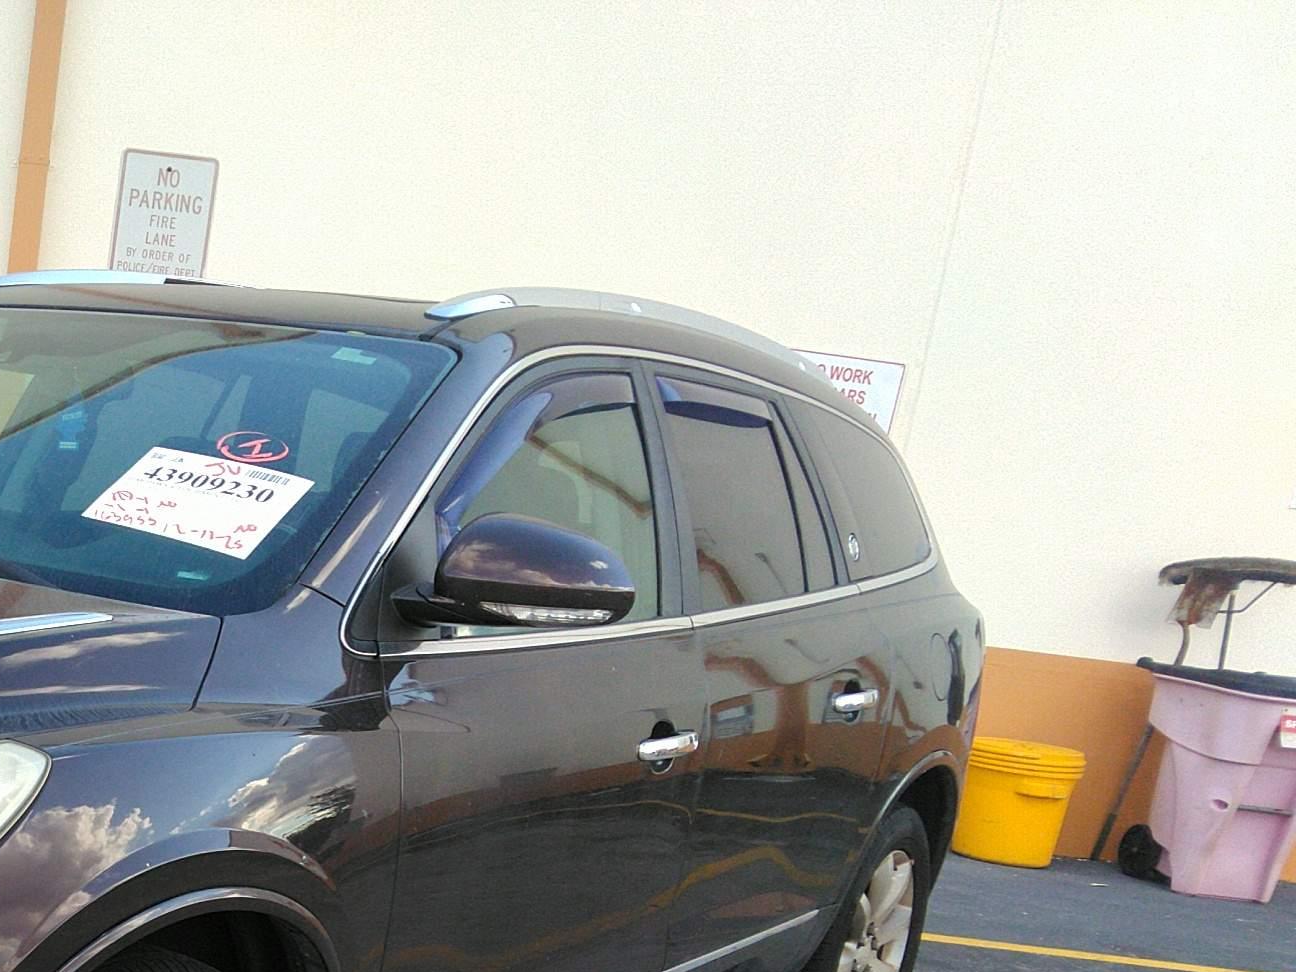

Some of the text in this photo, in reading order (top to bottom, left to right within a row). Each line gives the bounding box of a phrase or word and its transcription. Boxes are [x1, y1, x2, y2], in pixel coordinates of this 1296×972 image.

[157, 168, 180, 188] NO
[129, 188, 203, 214] PARKING
[149, 214, 177, 229] FIRE
[145, 232, 177, 247] LANE
[126, 246, 191, 264] BY ORDER OF
[830, 365, 874, 385] WORK
[144, 466, 275, 503] 43909230
